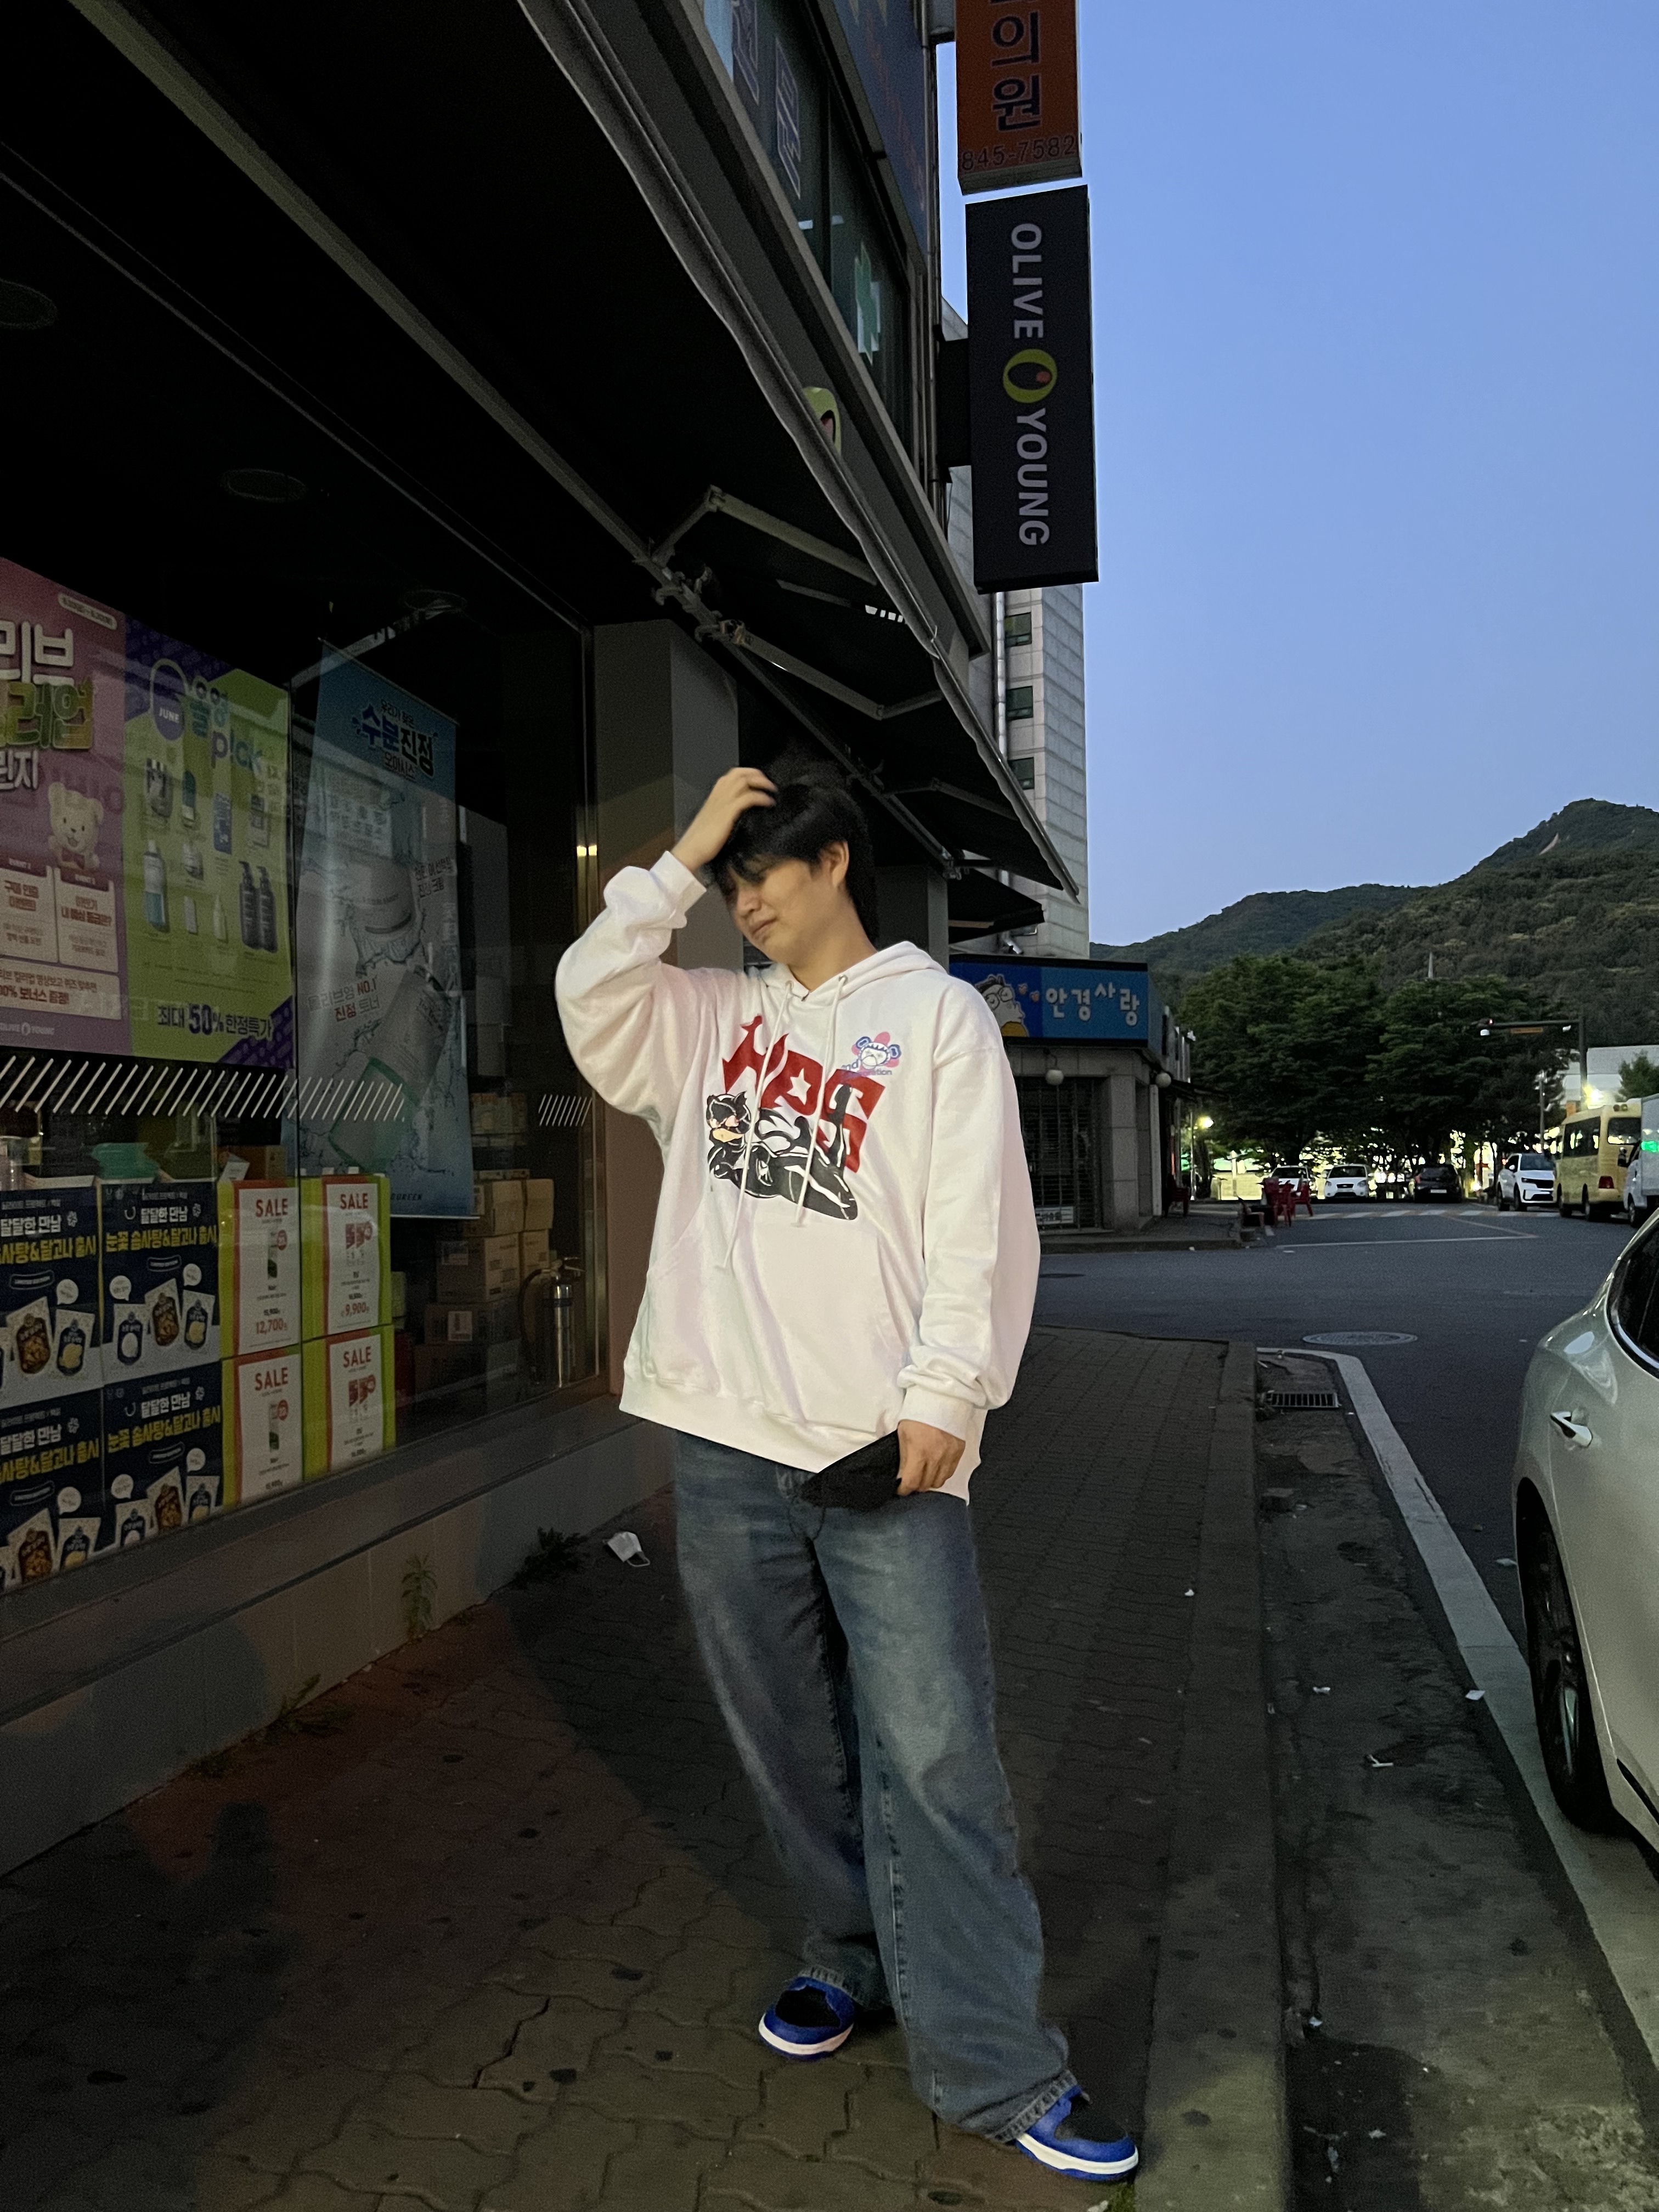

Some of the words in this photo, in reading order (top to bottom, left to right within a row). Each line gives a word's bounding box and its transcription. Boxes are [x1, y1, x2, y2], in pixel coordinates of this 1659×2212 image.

[991, 0, 1041, 132] 의원
[962, 135, 1075, 171] 845-7582
[1011, 223, 1043, 339] OLIVE
[1017, 408, 1050, 546] YOUNG
[159, 707, 180, 724] JUNE
[20, 987, 47, 1002] 보너스
[1046, 982, 1139, 1026] 안경사랑
[158, 1005, 185, 1028] 최대
[189, 1003, 224, 1035] 50%
[225, 1014, 272, 1038] 한정특가
[334, 1002, 357, 1022] 진정
[140, 1207, 168, 1224] 달달한
[169, 1206, 188, 1223] 만남
[256, 1198, 288, 1217] SALE
[340, 1193, 368, 1210] SALE
[1, 1217, 36, 1237] 달달한
[38, 1214, 61, 1233] 만남
[105, 1231, 129, 1252] 눈꽃
[130, 1226, 197, 1251] 솜사탕&달고나
[199, 1224, 217, 1245] 출시
[0, 1237, 74, 1264] 사탕&달고나
[75, 1235, 97, 1258] 출시
[343, 1346, 371, 1368] SALE
[255, 1367, 288, 1391] SALE
[140, 1397, 169, 1419] 달달한
[170, 1392, 190, 1411] 만남
[0, 1430, 35, 1456] 달달한
[37, 1424, 61, 1446] 만남
[0, 1444, 74, 1482] 사탕&달고나
[76, 1438, 100, 1463] 출시
